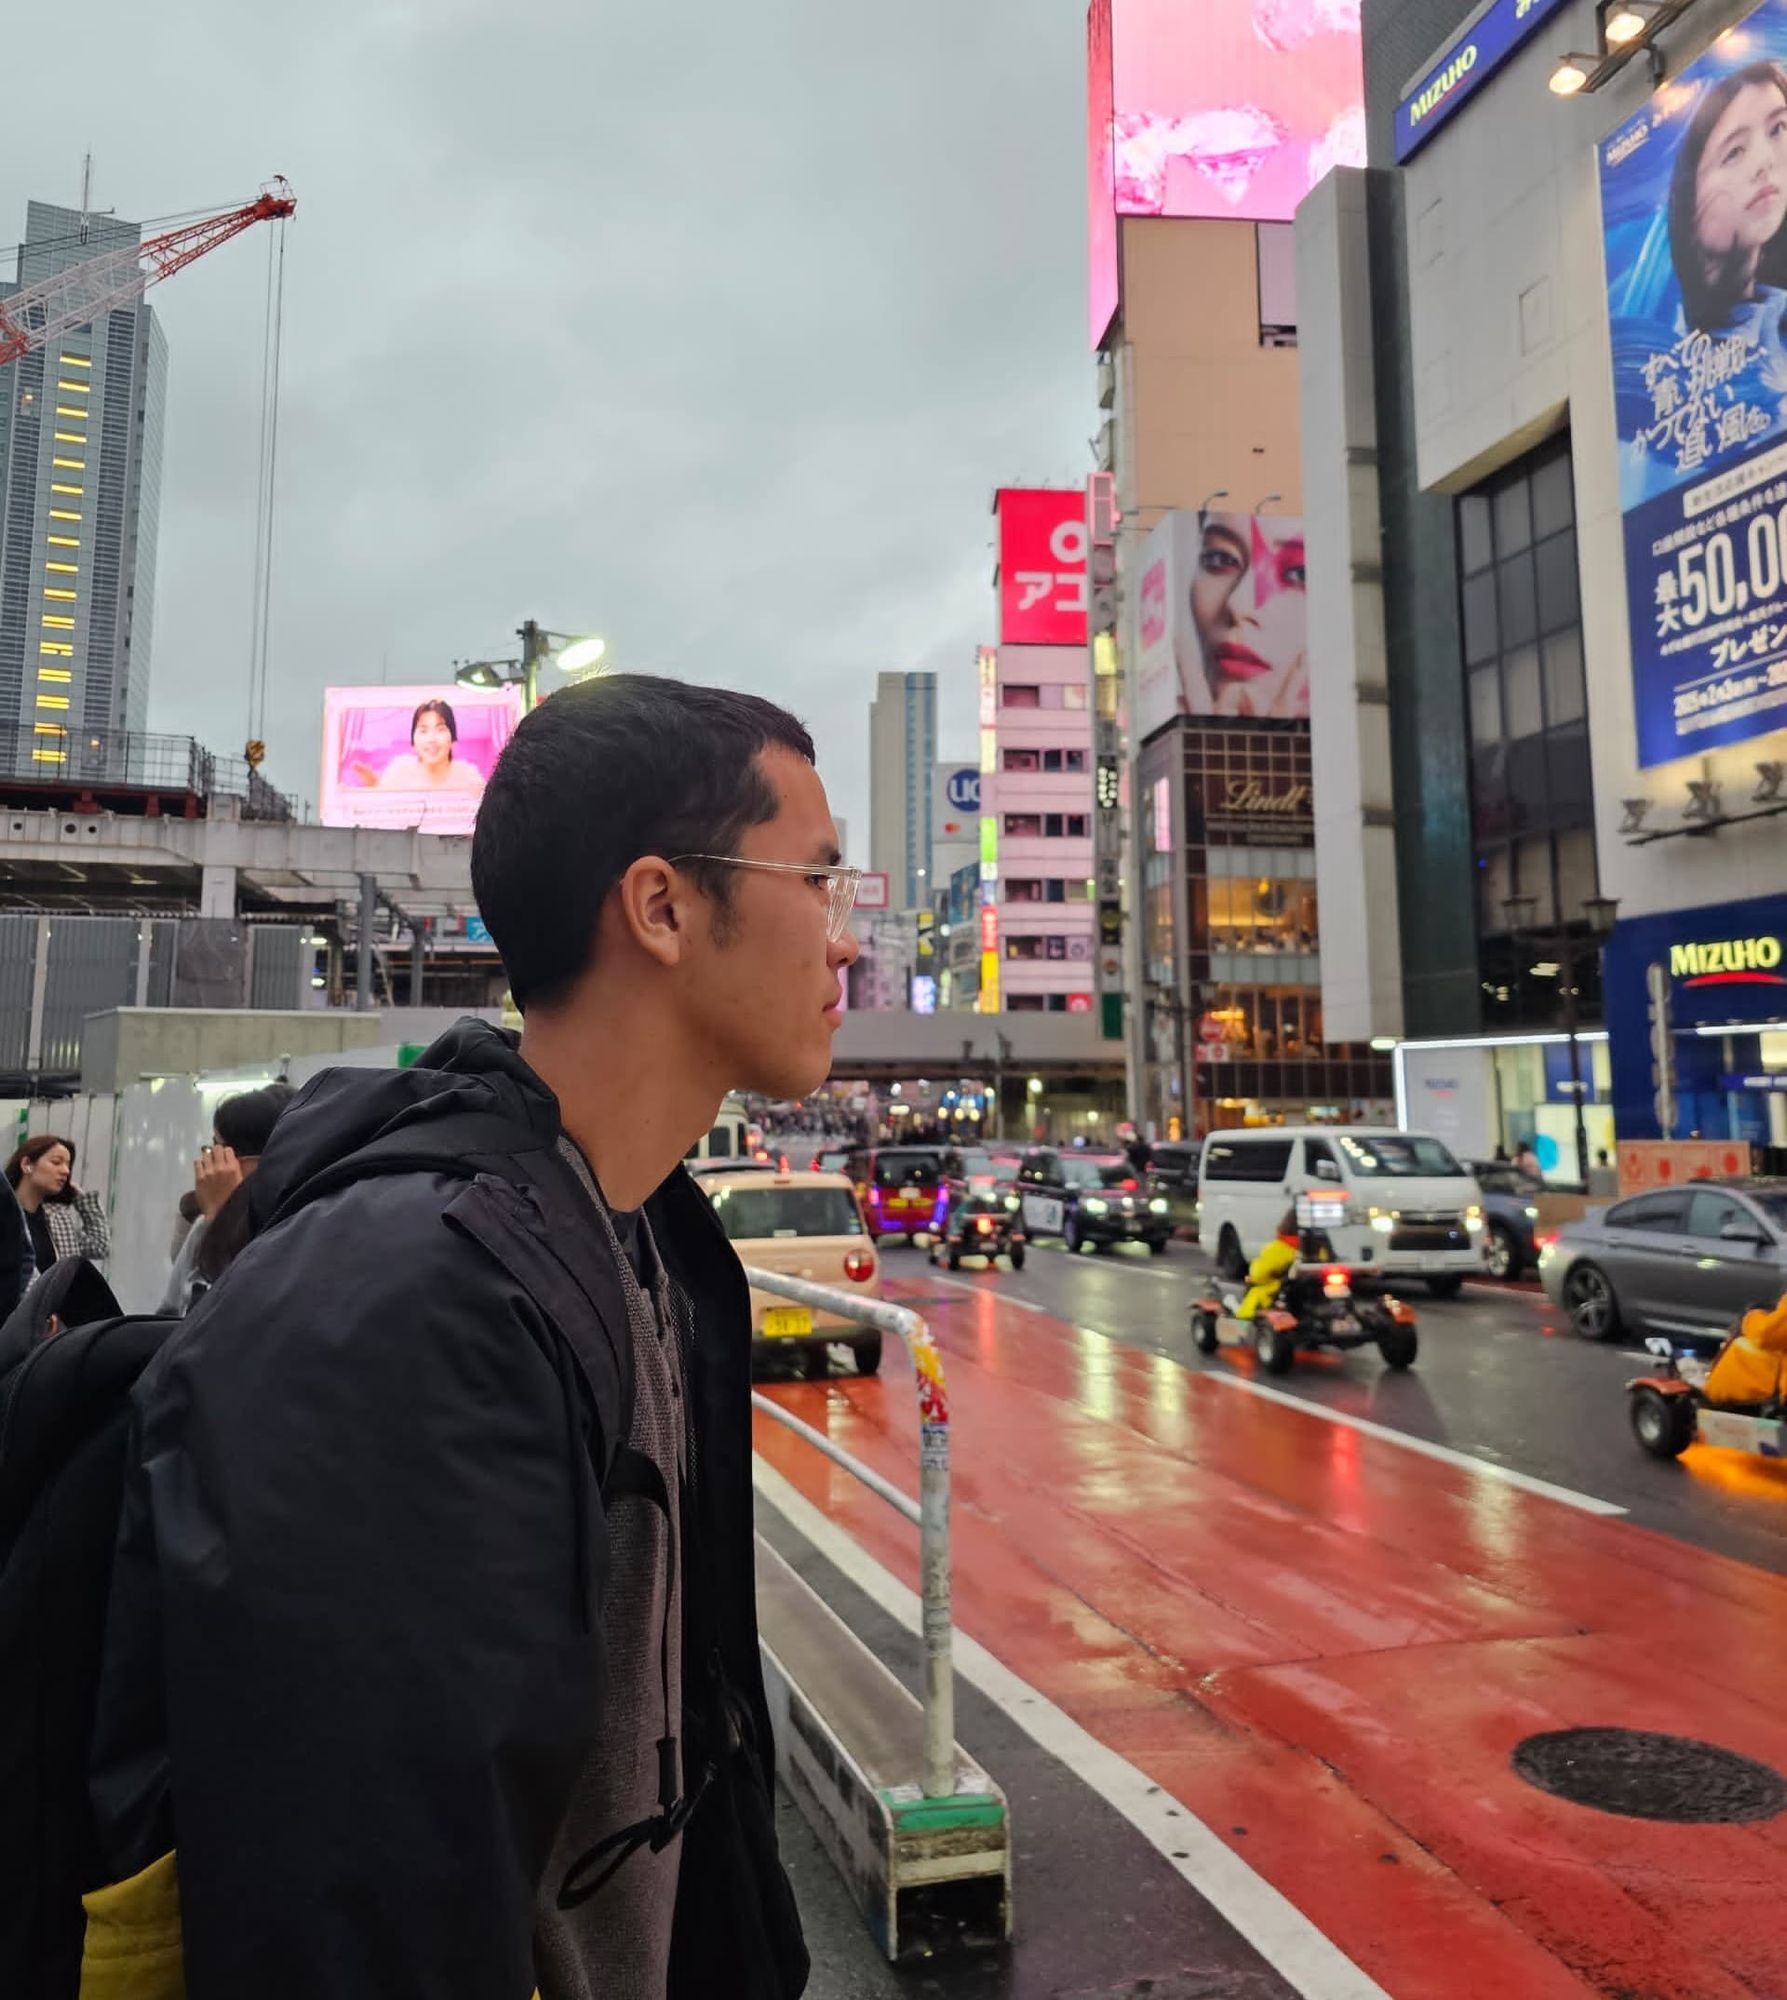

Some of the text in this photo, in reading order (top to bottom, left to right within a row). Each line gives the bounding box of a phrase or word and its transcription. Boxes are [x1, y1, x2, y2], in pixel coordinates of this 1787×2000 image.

[1408, 44, 1478, 127] MIZUHO
[1219, 780, 1307, 811] Lindt
[1670, 936, 1781, 977] MIZUHO
